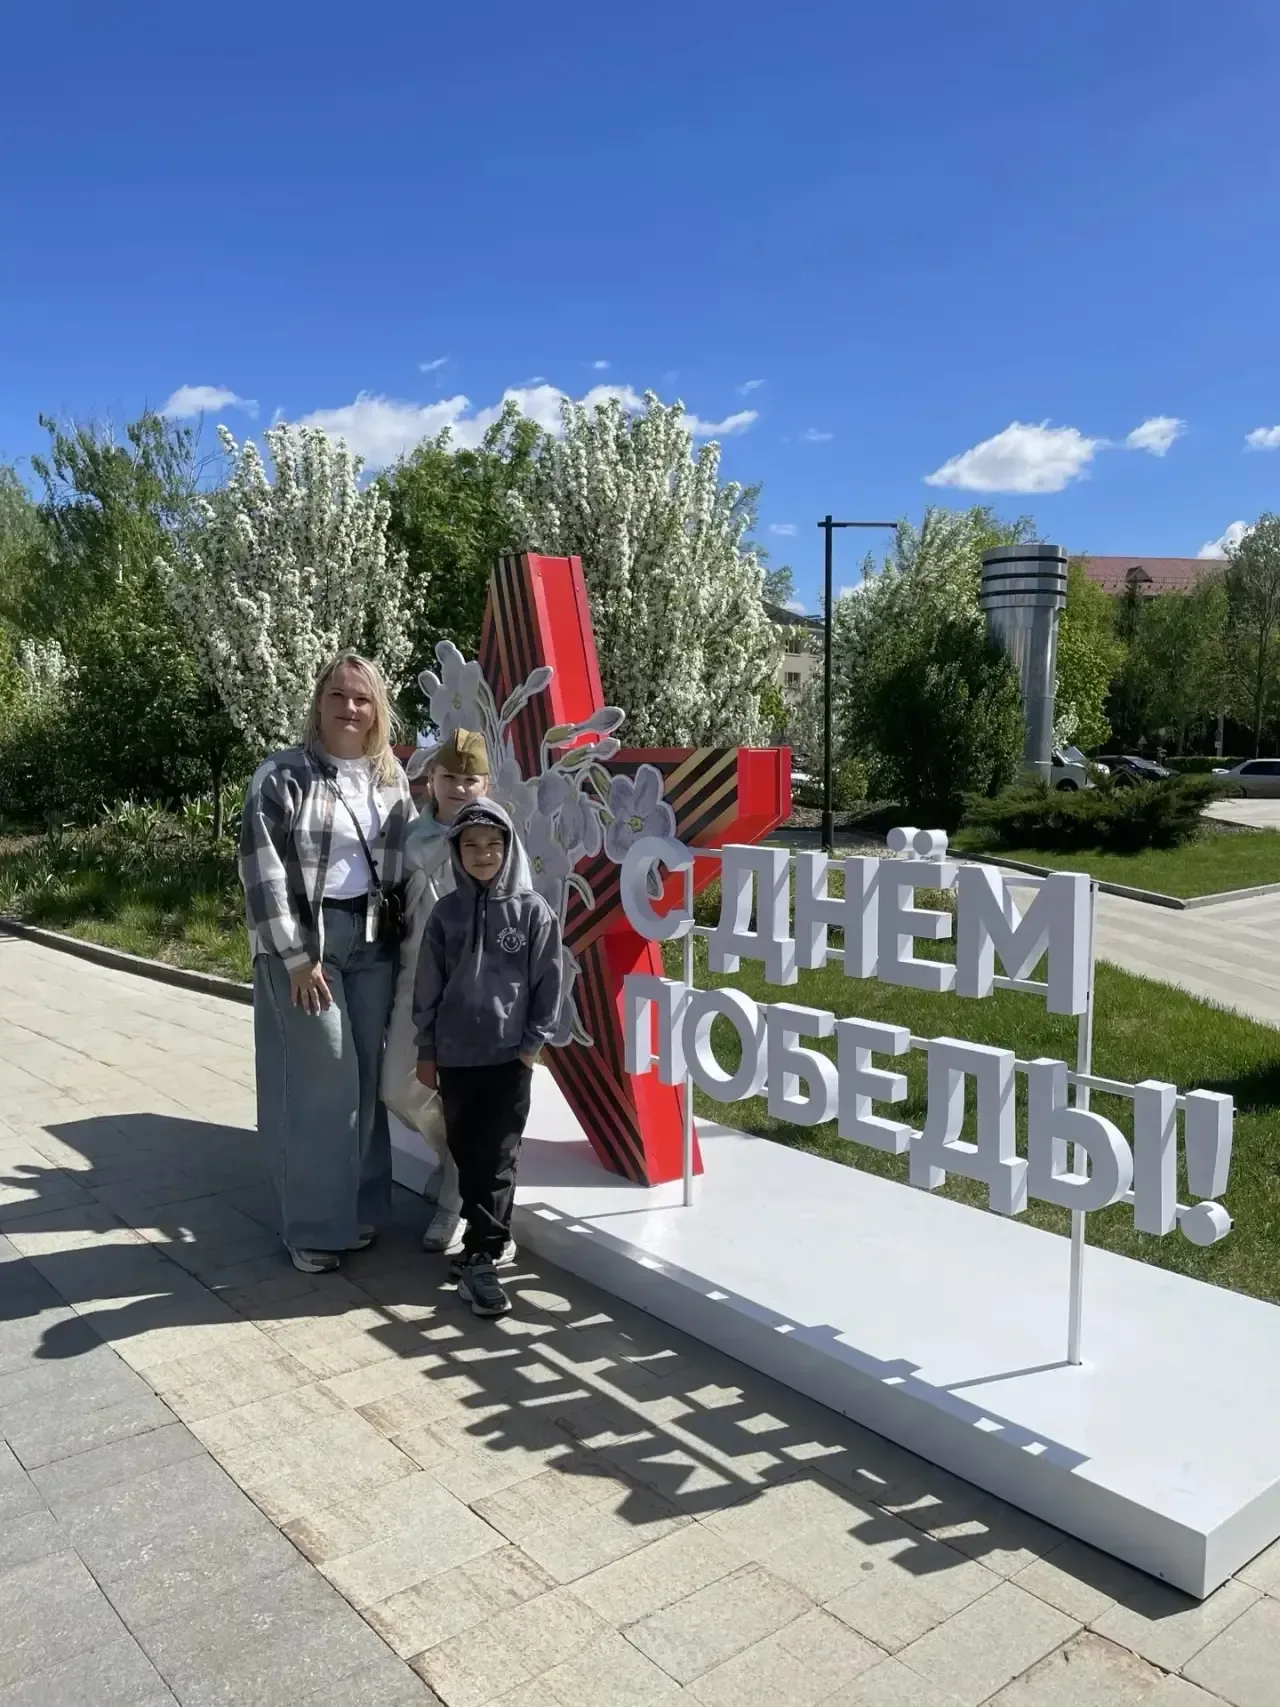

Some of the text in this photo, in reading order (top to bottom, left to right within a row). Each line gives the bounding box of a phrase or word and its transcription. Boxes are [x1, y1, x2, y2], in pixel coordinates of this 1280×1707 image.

[620, 826, 1091, 1016] С ДНЁМ
[623, 974, 1234, 1247] ПОБЕДЫ!
